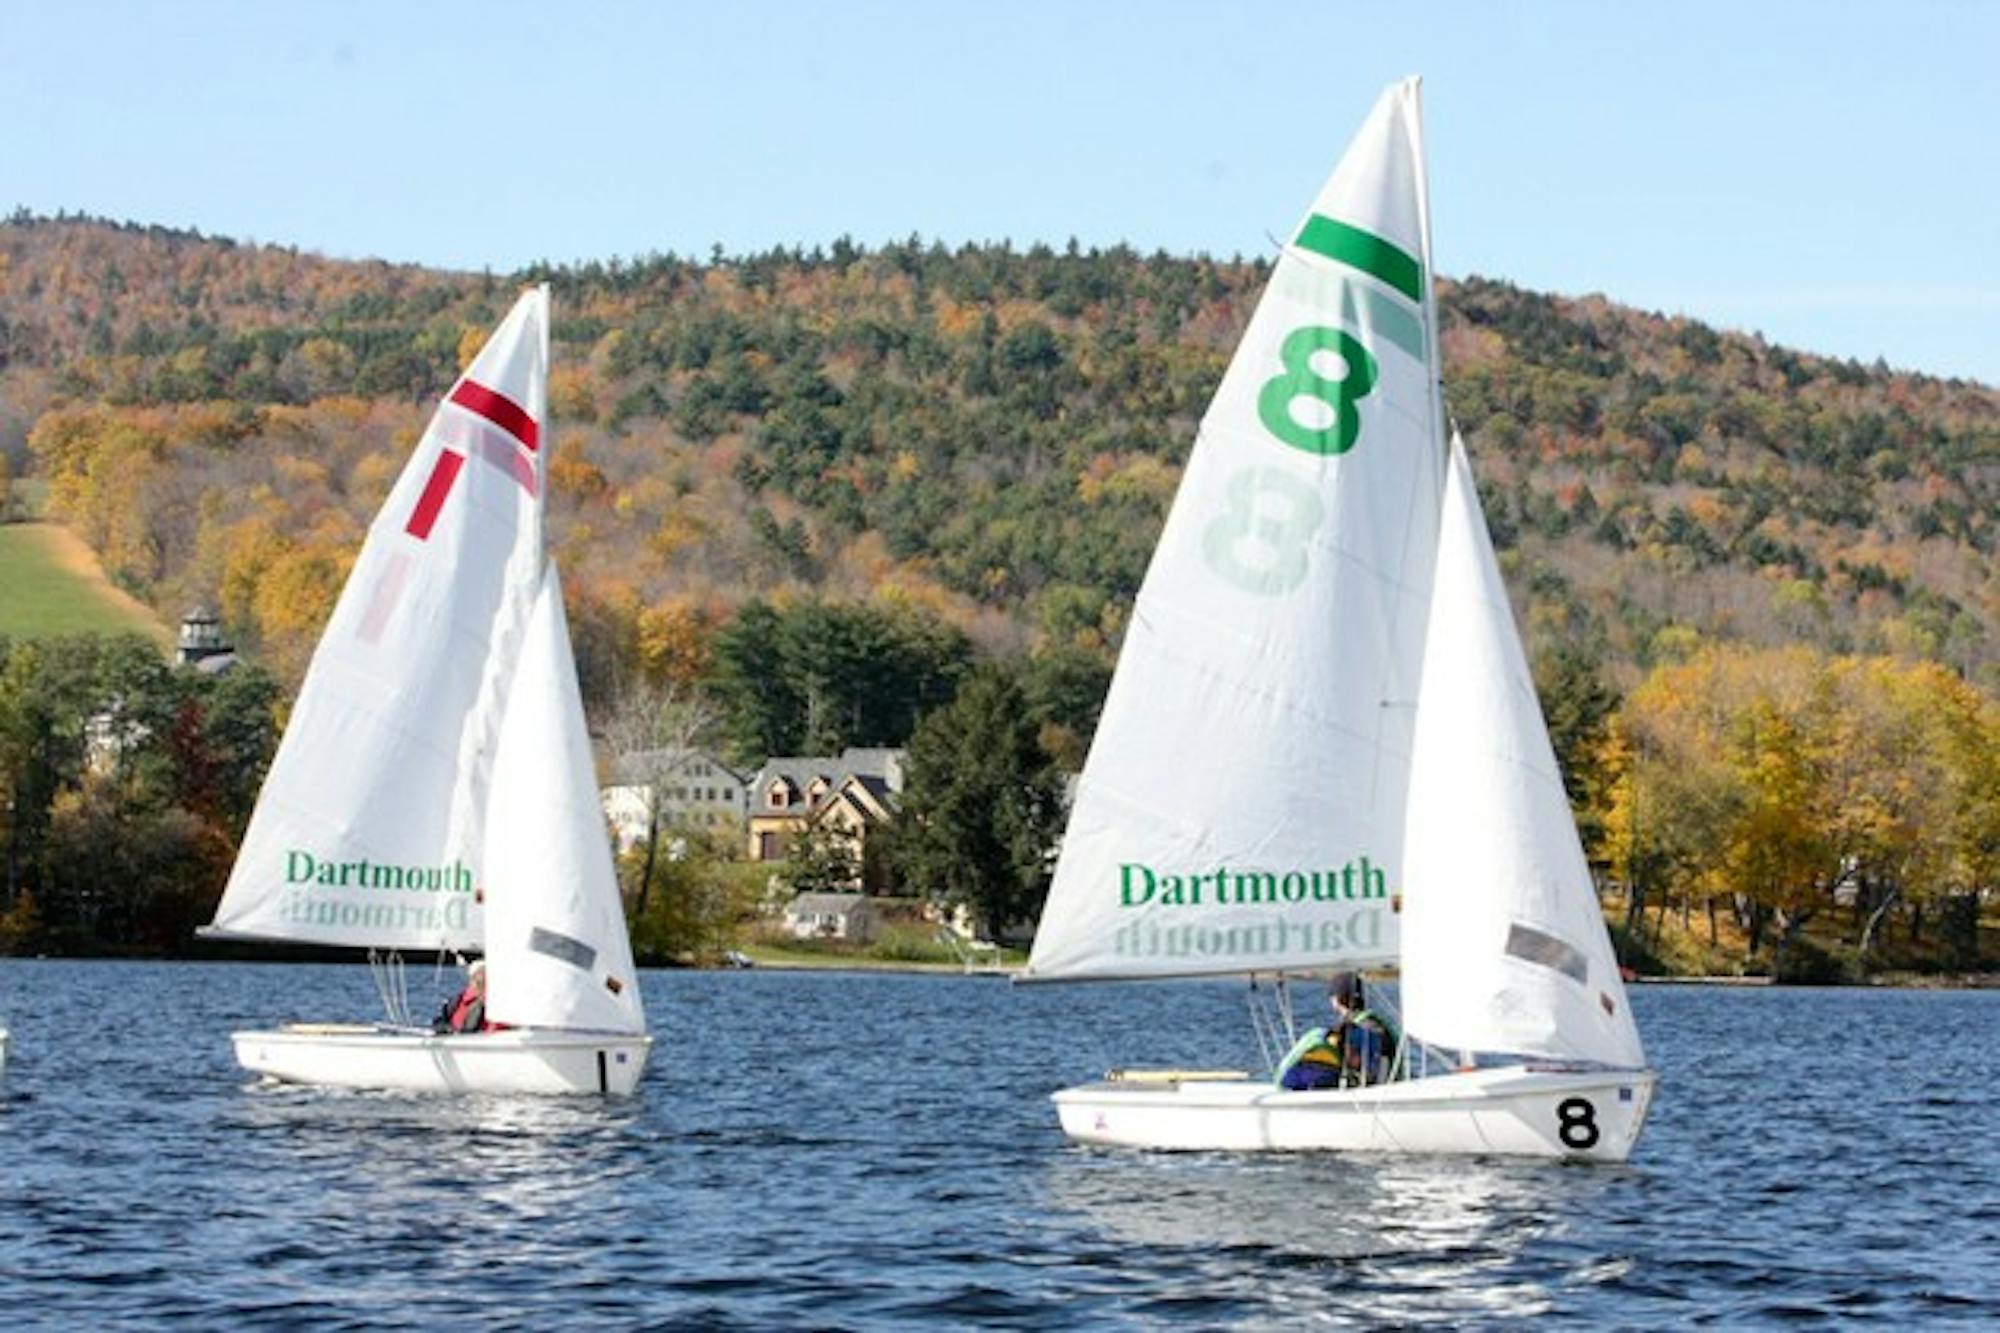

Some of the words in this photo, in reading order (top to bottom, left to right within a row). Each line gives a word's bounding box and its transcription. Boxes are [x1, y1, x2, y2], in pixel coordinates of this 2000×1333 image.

[1258, 325, 1378, 457] 8
[285, 850, 472, 893] Dartmouth
[1118, 856, 1387, 908] Dartmouth
[597, 1050, 608, 1093] 1
[1556, 1096, 1599, 1149] 8
